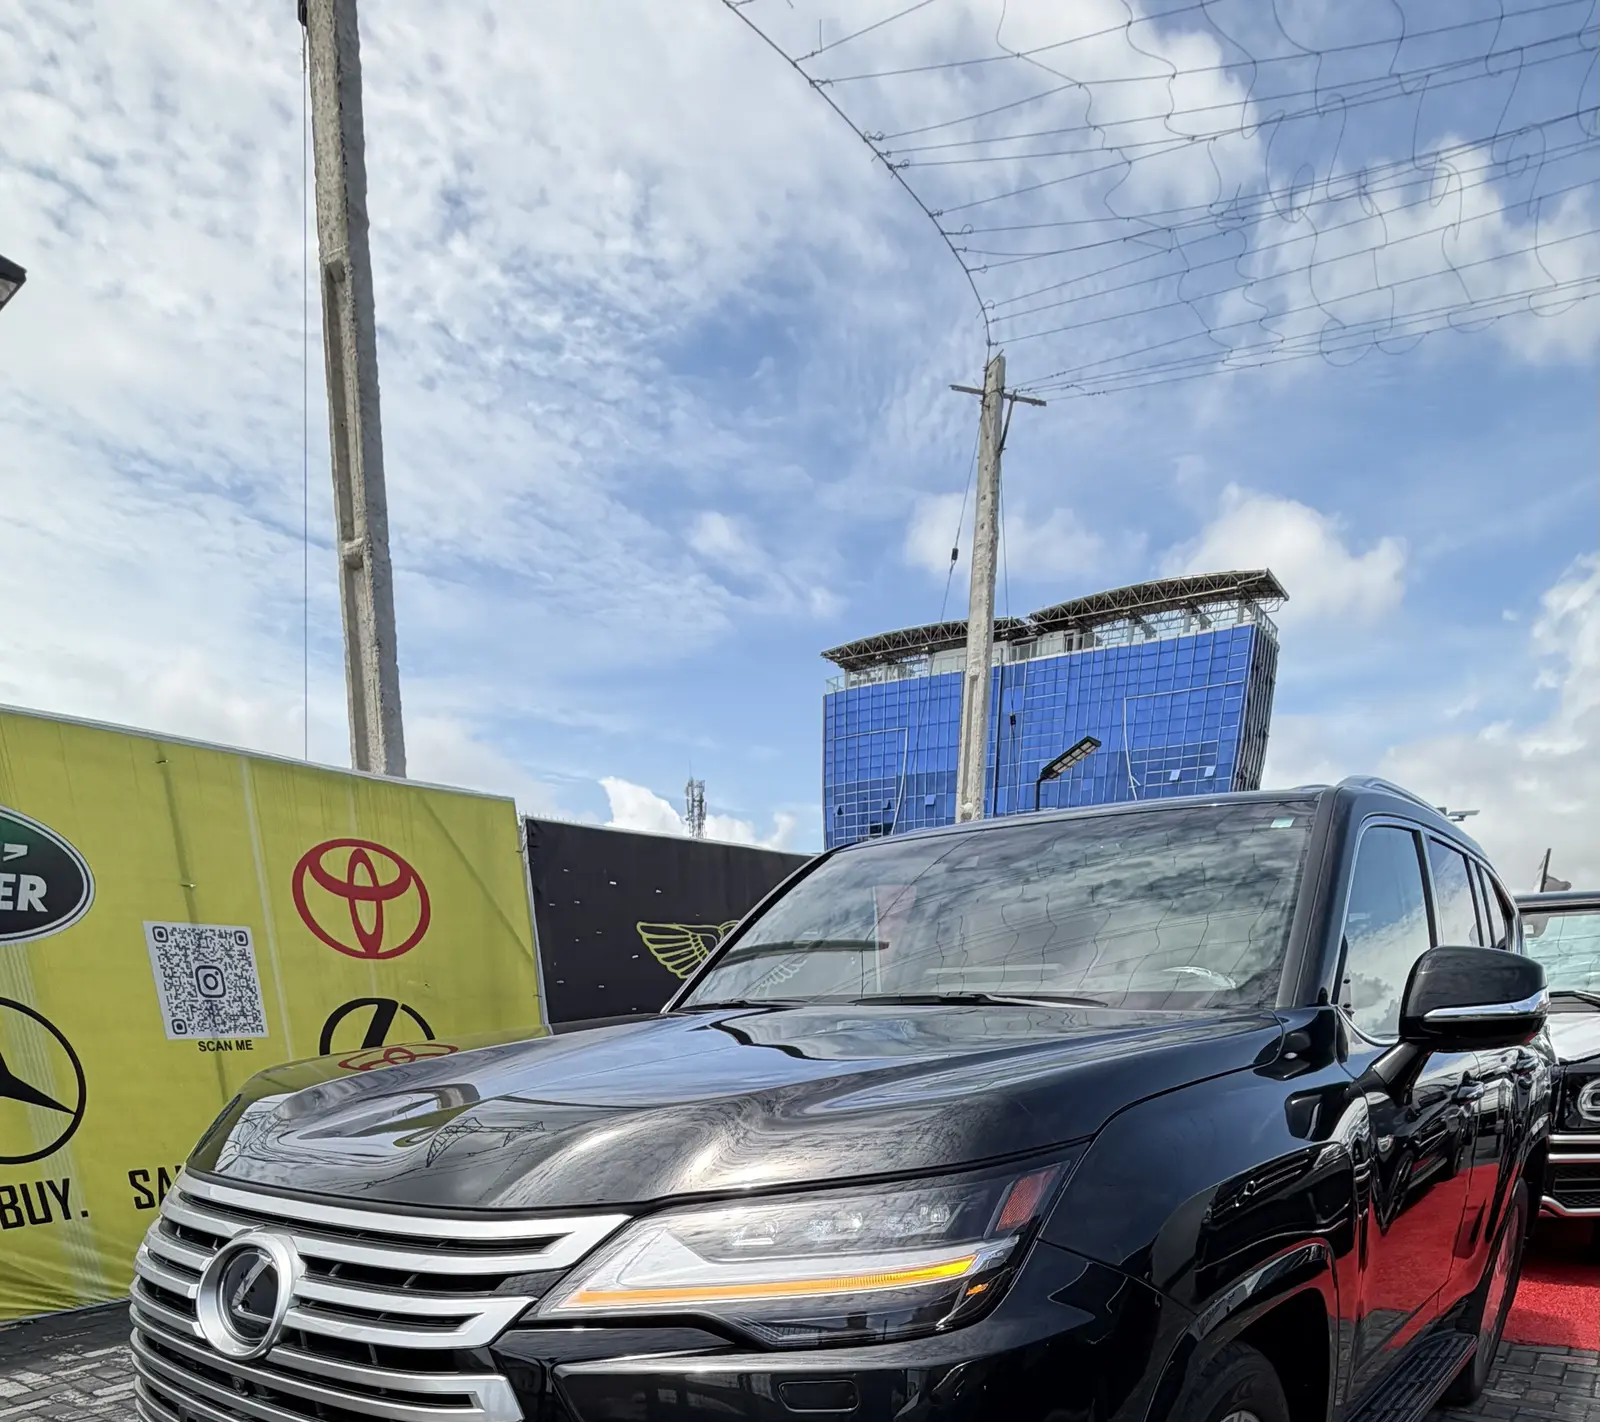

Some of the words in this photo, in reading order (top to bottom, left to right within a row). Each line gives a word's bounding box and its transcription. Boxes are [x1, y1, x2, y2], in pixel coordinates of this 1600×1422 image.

[198, 1040, 233, 1052] SCAN
[235, 1039, 254, 1051] ME
[0, 1177, 89, 1230] BUY.
[128, 1165, 182, 1210] SA
